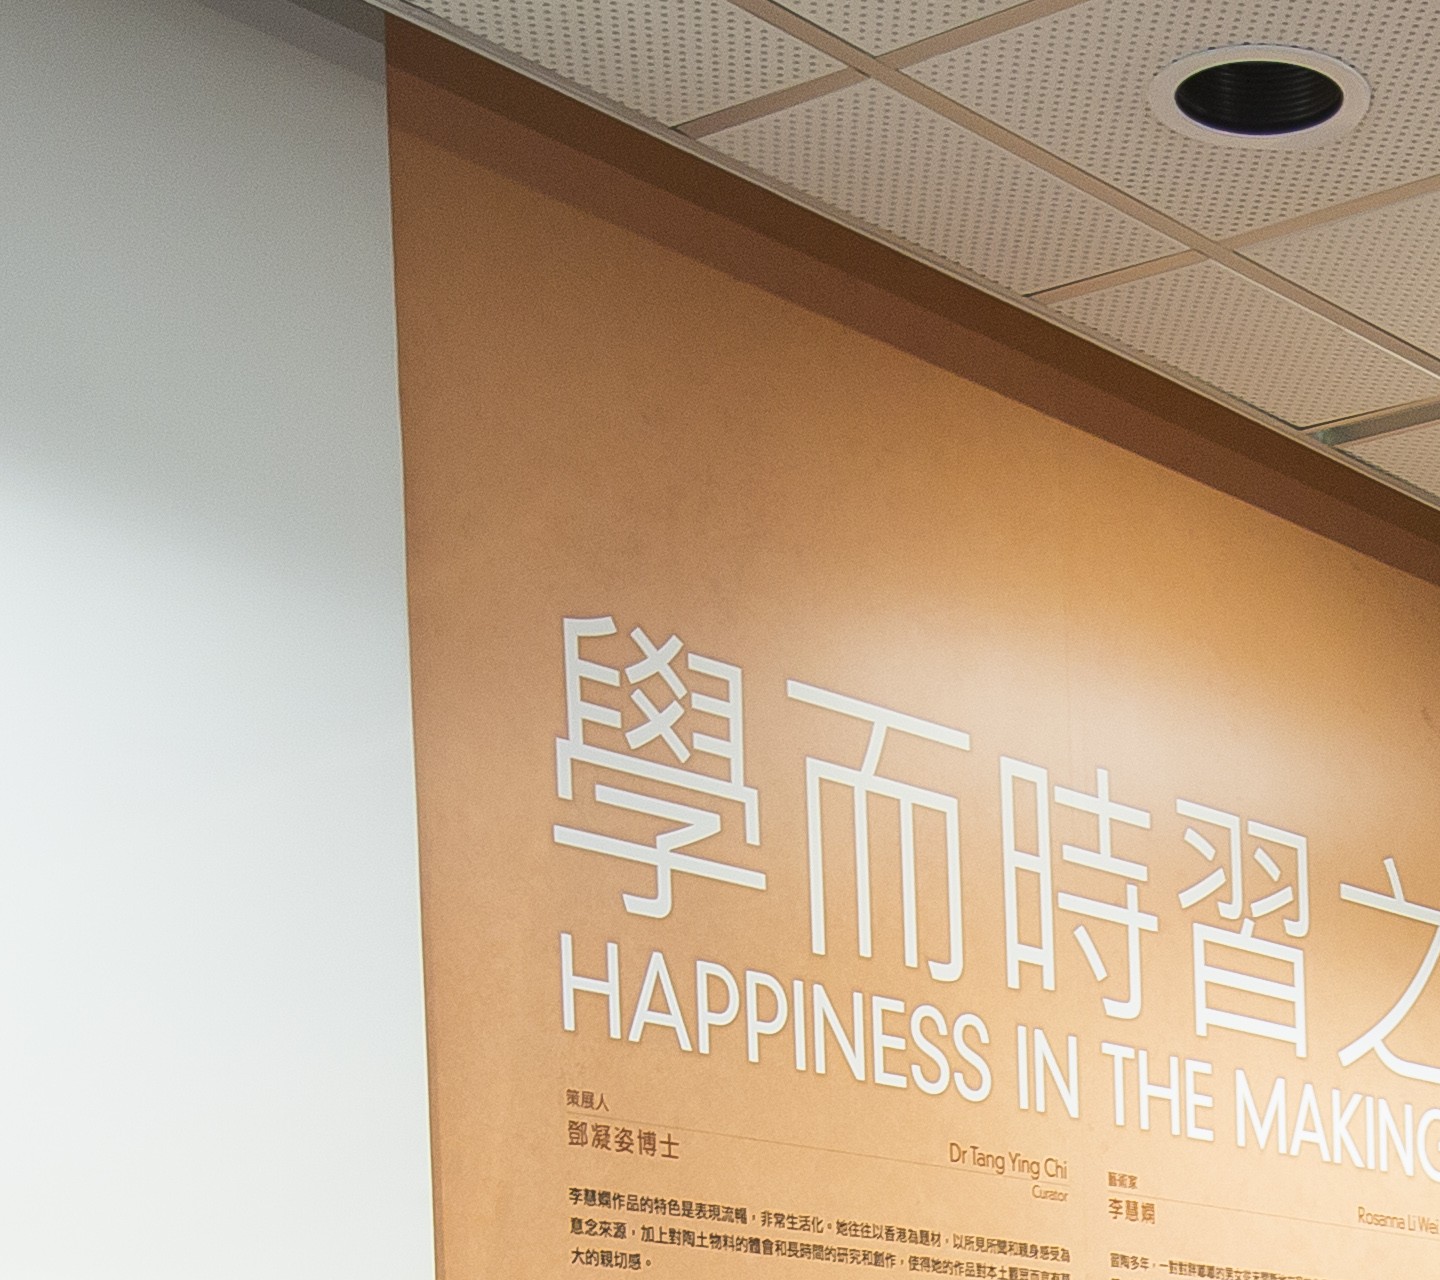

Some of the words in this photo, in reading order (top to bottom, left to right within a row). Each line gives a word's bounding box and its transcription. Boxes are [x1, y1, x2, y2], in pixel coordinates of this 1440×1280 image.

[560, 932, 992, 1103] HAPPINESS
[1017, 1024, 1079, 1119] IN
[1101, 1041, 1215, 1142] THE
[566, 1089, 610, 1112] 策展人
[567, 1119, 680, 1160] 鄧凝姿博士
[949, 1142, 967, 1164] Dr
[970, 1145, 1005, 1175] Tang
[1008, 1151, 1040, 1180] Ying
[1044, 1157, 1067, 1179] Chi
[1032, 1184, 1068, 1202] Curator
[1357, 1206, 1406, 1230] Rosanna
[1407, 1214, 1416, 1231] Li
[1417, 1215, 1439, 1235] Wei
